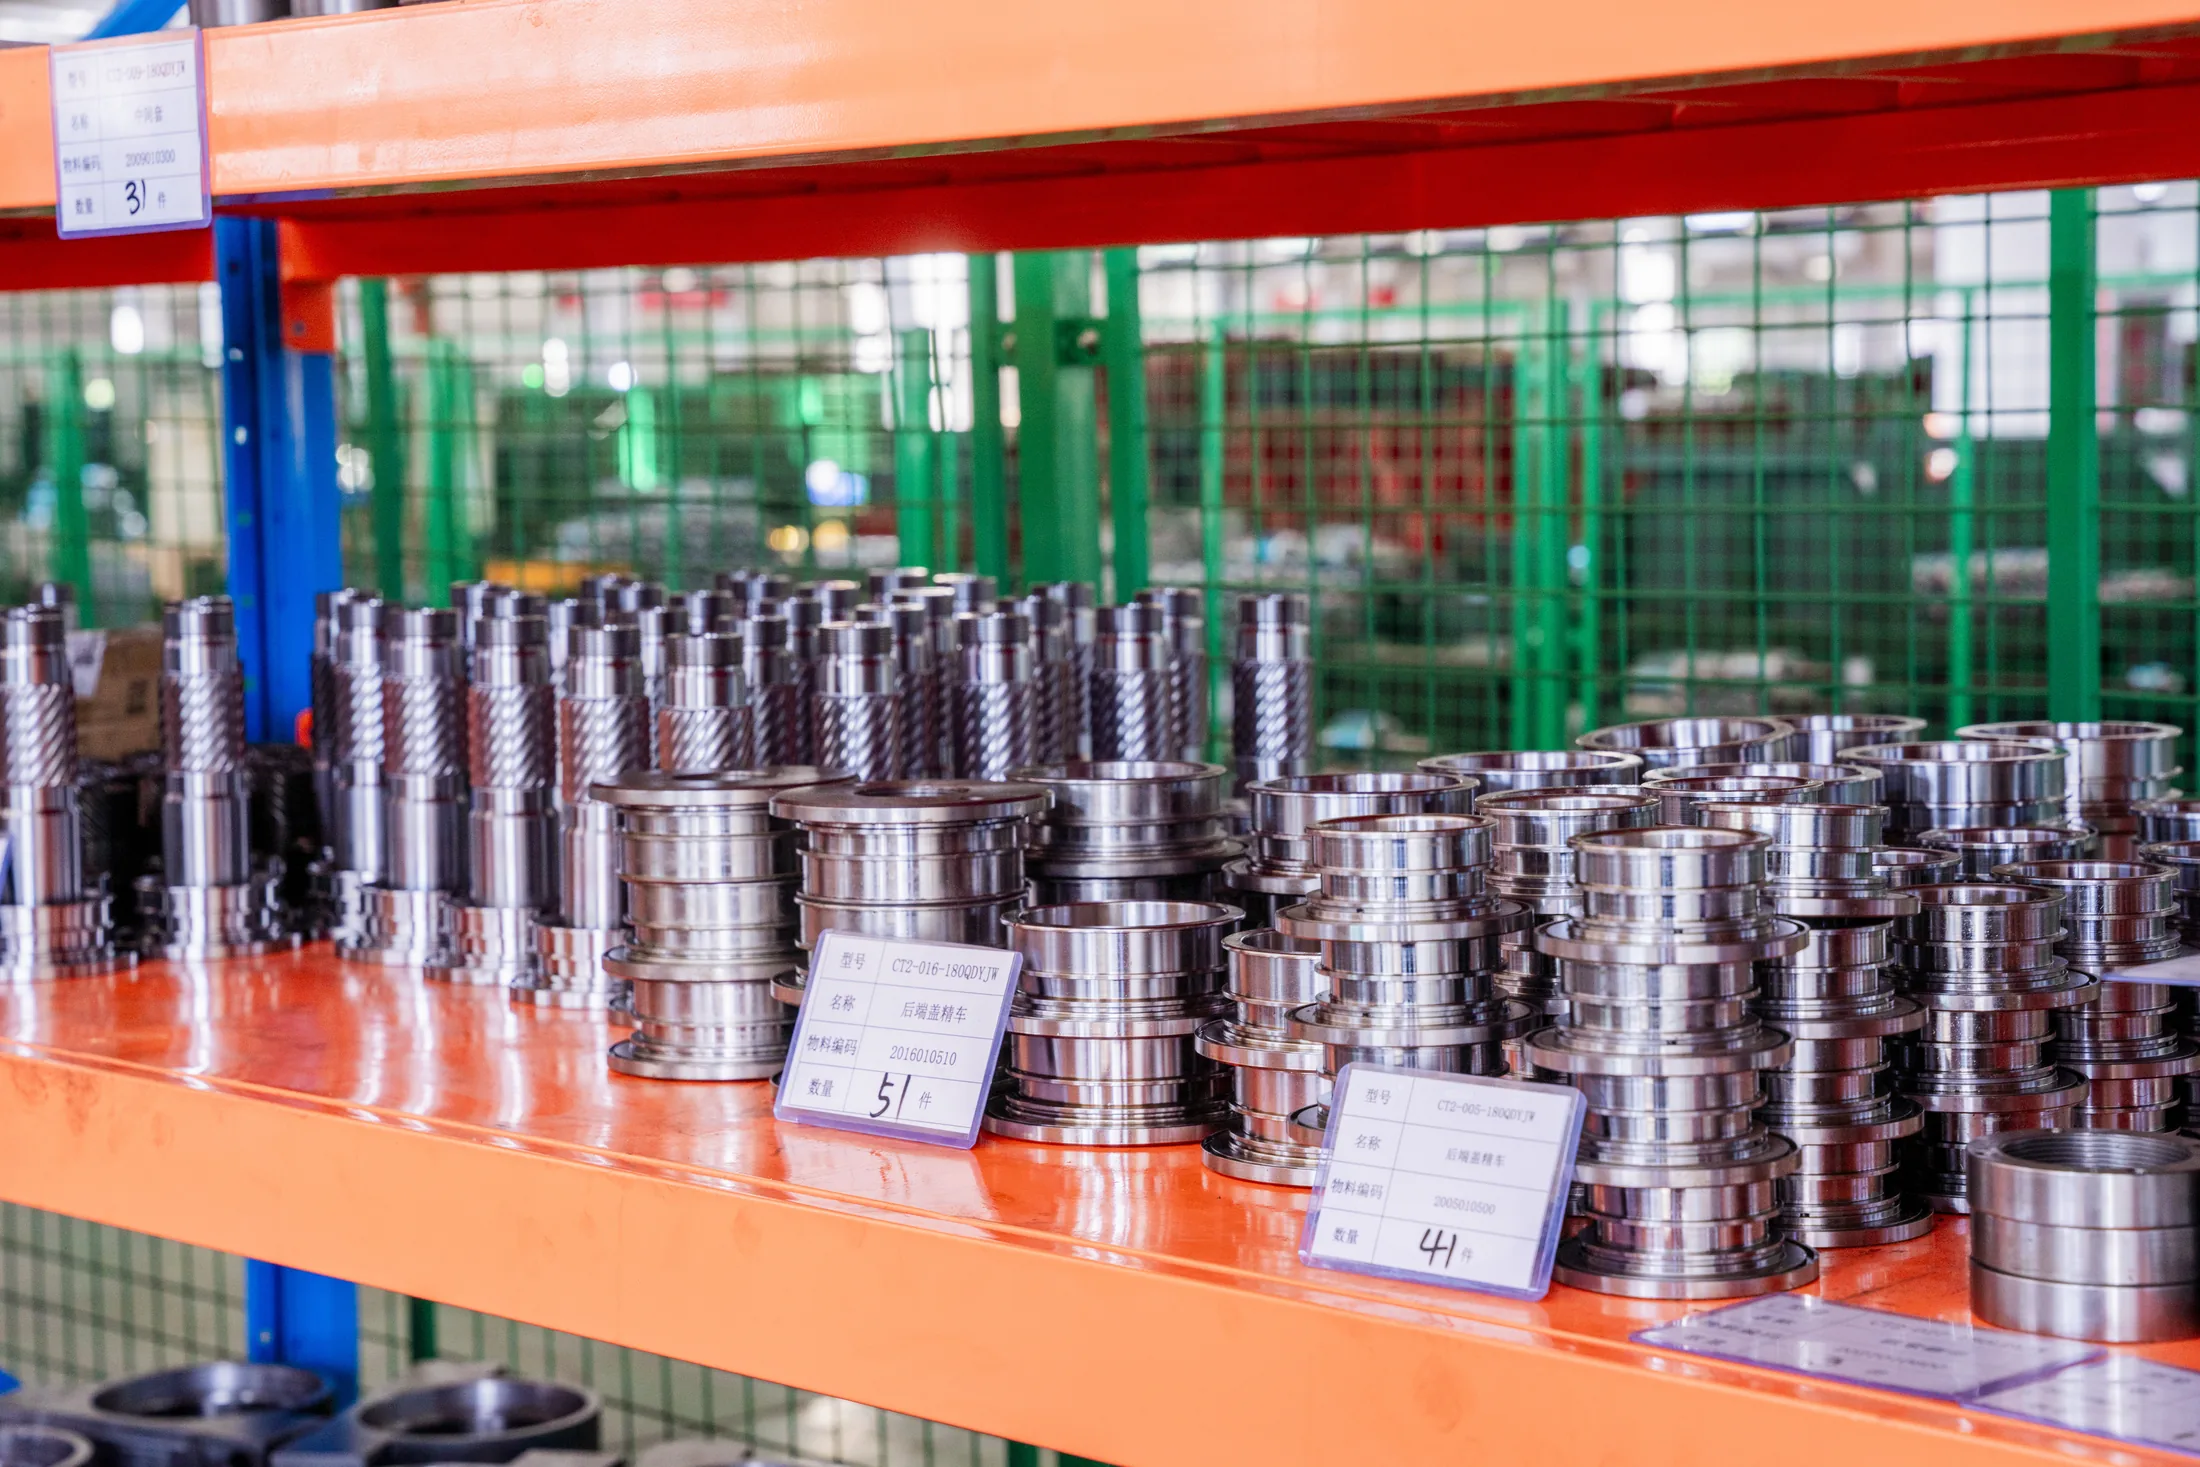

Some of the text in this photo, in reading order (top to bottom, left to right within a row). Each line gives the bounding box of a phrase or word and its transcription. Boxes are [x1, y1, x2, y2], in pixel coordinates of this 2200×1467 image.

[75, 179, 166, 215] 数量 31 件
[840, 951, 1000, 982] 型号 CT2-016-180QDYJW
[830, 993, 968, 1024] 名称 后端盖精车
[807, 1034, 957, 1066] 物料编码 2016010510
[807, 1072, 932, 1122] 数量 51 件
[1365, 1088, 1536, 1124] 型号 CT2-005-180QDYJW
[1355, 1134, 1507, 1167] 名称 后端盖精车
[1331, 1178, 1497, 1216] 物料编码 2005010500
[1332, 1227, 1474, 1269] 数量 41 件
